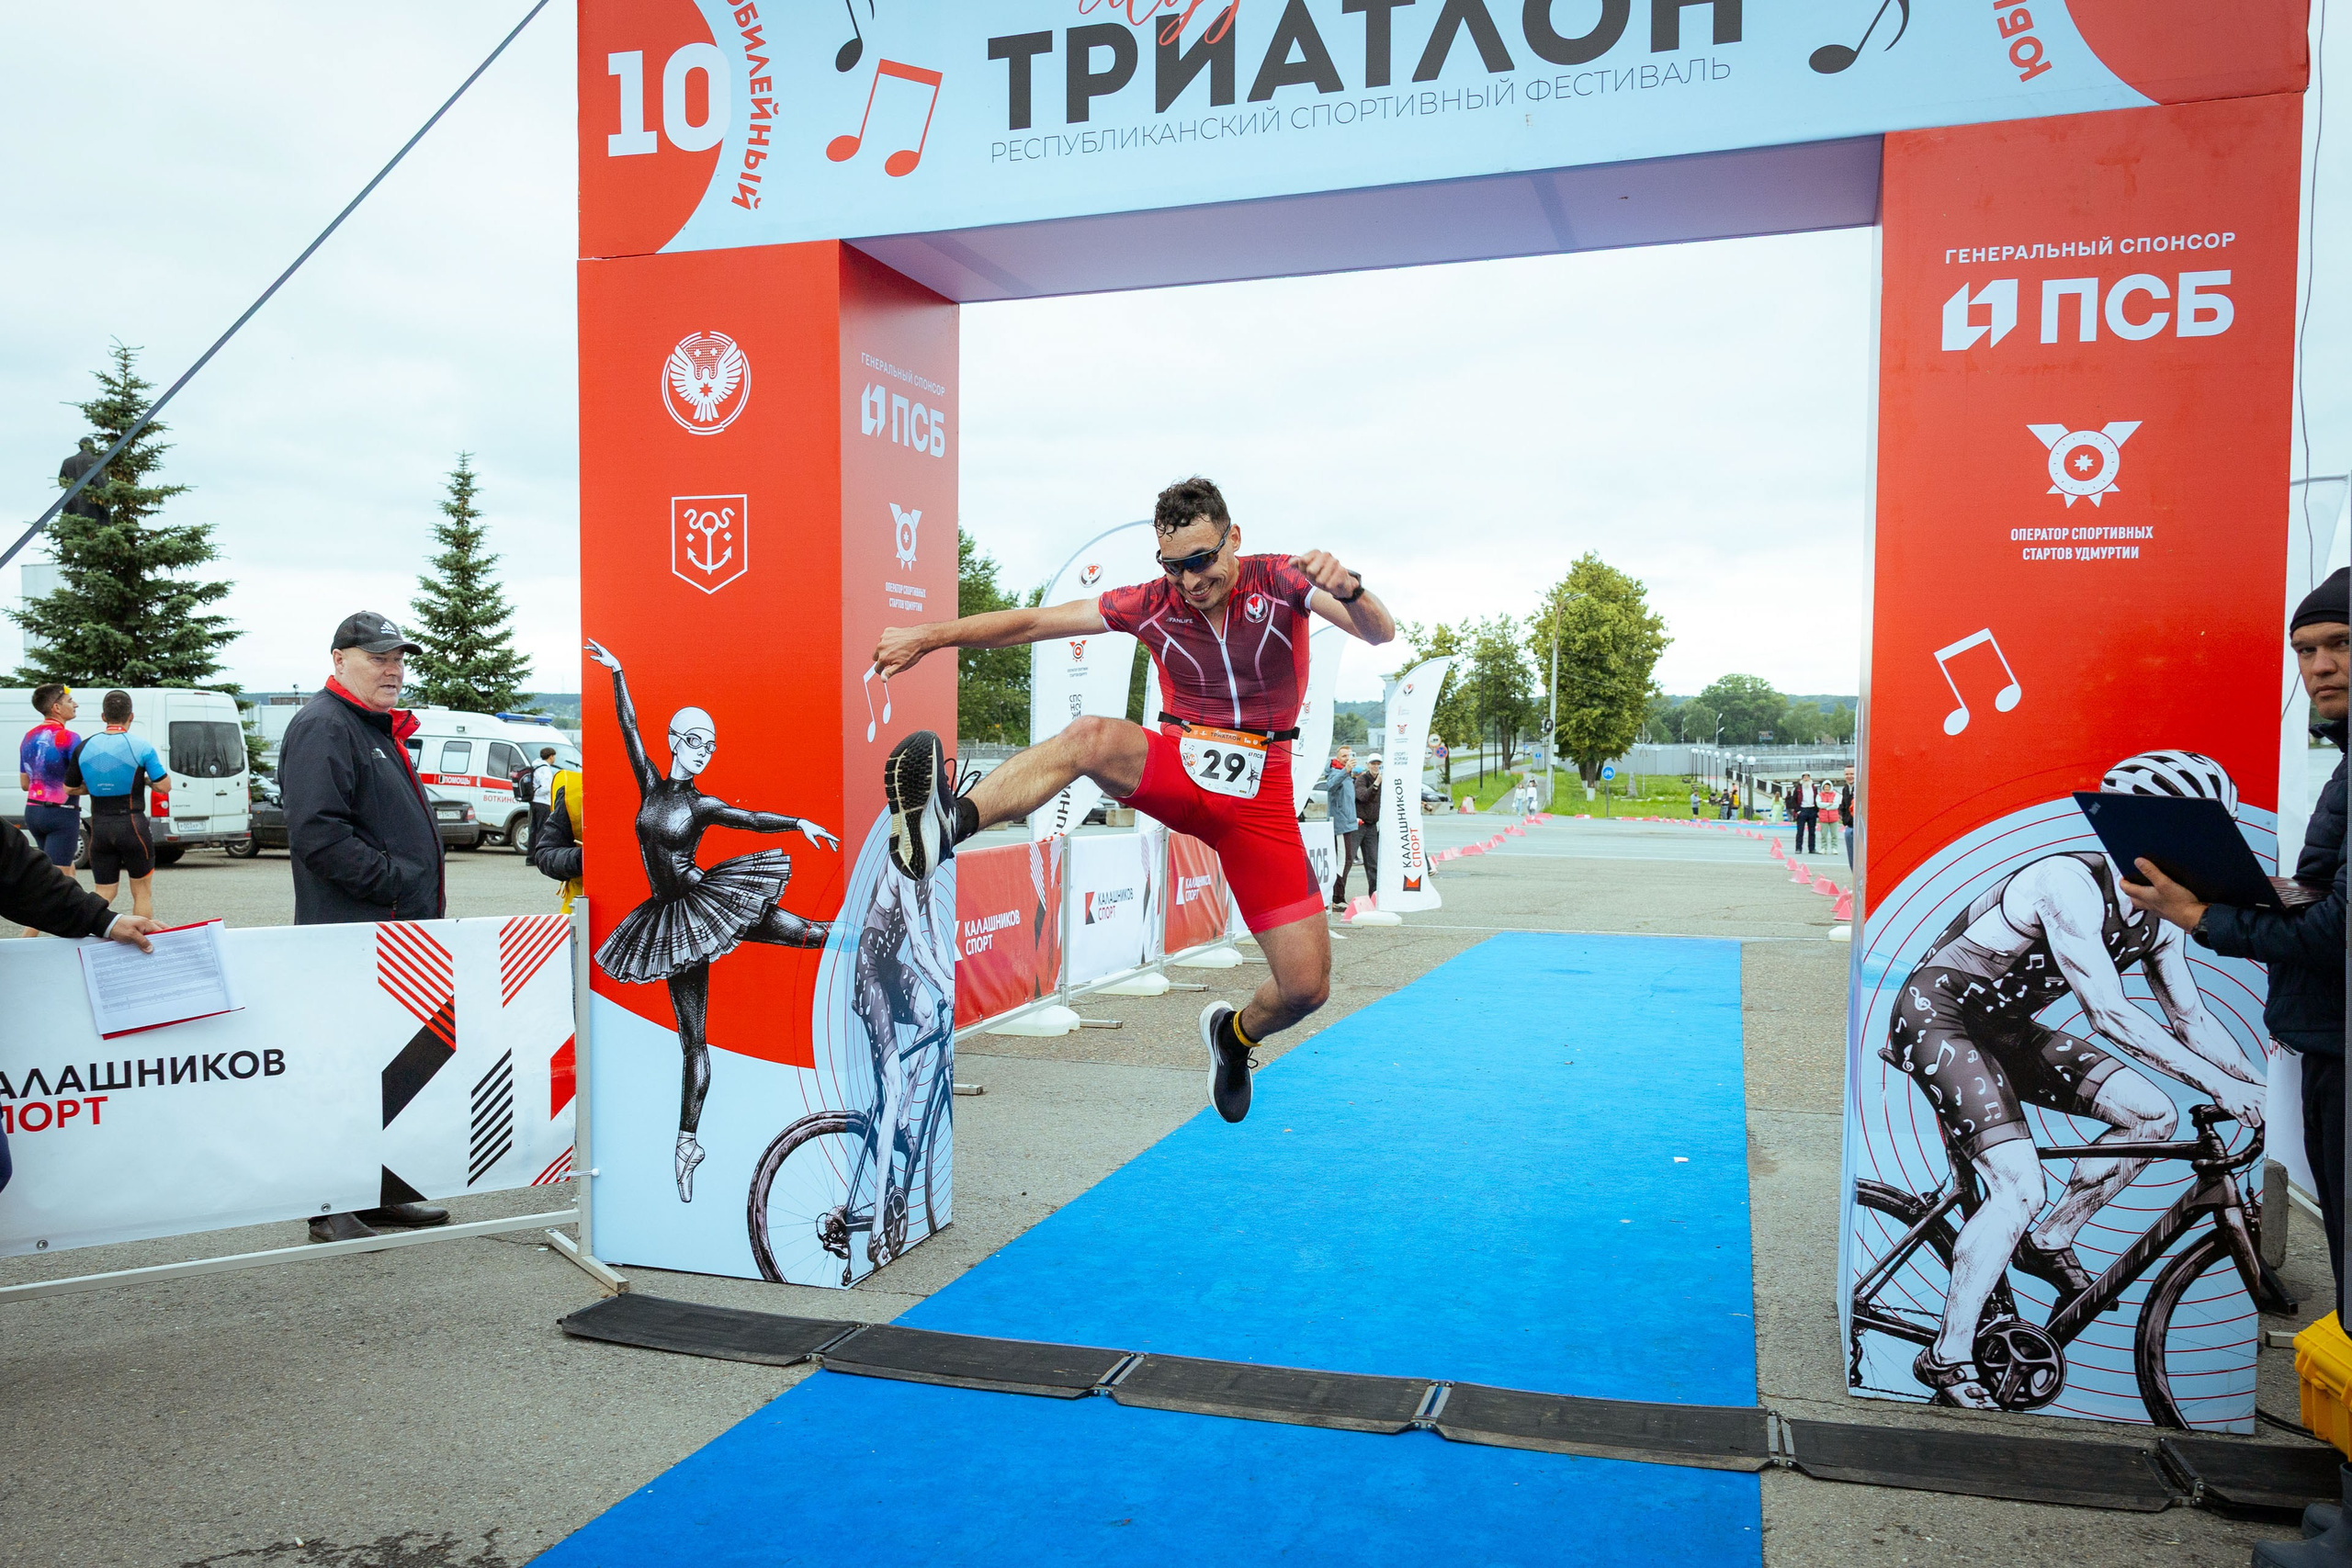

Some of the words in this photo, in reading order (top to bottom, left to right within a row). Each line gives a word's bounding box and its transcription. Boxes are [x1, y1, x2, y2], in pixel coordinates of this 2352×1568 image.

[1993, 0, 2052, 83] ЮБ
[607, 42, 731, 157] 10
[726, 0, 779, 210] БИЛЕЙНЫЙ
[991, 106, 1280, 164] РЕСПУБЛИКАНСКИЙ
[1290, 78, 1515, 130] СПОРТИВНЫЙ
[1525, 57, 1731, 103] ФЕСТИВАЛЬ
[1945, 236, 2113, 264] ГЕНЕРАЛЬНЫЙ
[2120, 231, 2236, 254] СПОНСОР
[2040, 269, 2235, 344] ПСБ
[861, 352, 913, 385] ГЕНЕРАЛЬНЫЙ
[913, 375, 945, 396] СПОНСОР
[891, 392, 945, 458] ПСБ
[2010, 527, 2070, 541] ОПЕРАТОР
[2071, 525, 2154, 540] СПОРТИВНЫХ
[2022, 547, 2073, 560] СТАРТОВ
[2075, 546, 2140, 561] УДМУРТИИ
[1199, 749, 1246, 783] 29
[1395, 778, 1412, 868] КАЛАШНИКОВ
[1409, 828, 1422, 868] СПОРТ
[965, 909, 1021, 938] КАЛАШНИКОВ
[965, 933, 993, 956] СПОРТ
